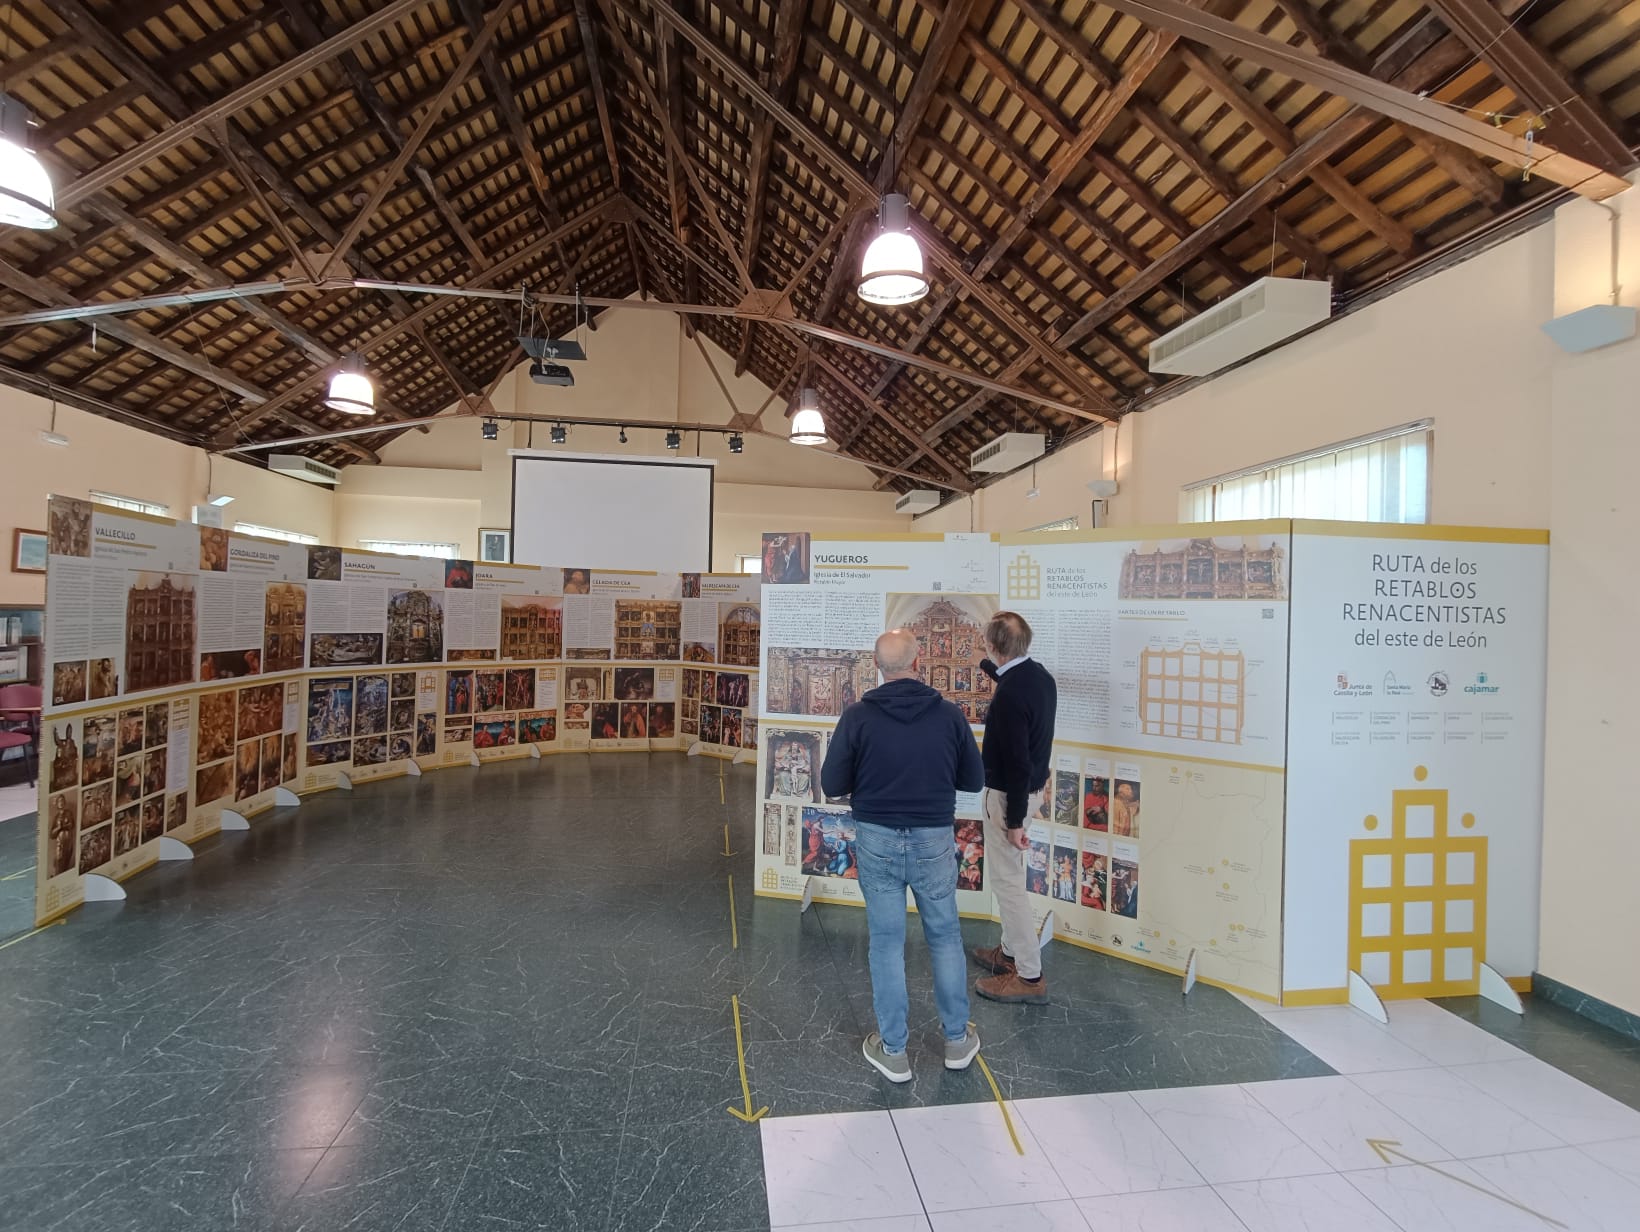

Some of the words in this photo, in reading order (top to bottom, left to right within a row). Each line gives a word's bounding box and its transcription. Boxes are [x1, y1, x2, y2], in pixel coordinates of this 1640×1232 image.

[95, 527, 136, 541] VALLECILLO
[814, 554, 869, 564] YUGUEROS
[1372, 553, 1426, 574] RUTA
[1430, 556, 1451, 574] de
[1455, 557, 1478, 576] los
[813, 570, 832, 579] Iglesia
[846, 571, 871, 579] Salvador
[1046, 582, 1108, 590] RENACENTISTAS
[1374, 578, 1477, 599] RETABLOS
[1342, 602, 1507, 625] RENACENTISTAS
[1354, 628, 1380, 647] del
[1384, 631, 1419, 648] este
[1423, 629, 1444, 648] de
[1448, 630, 1488, 649] León
[1463, 685, 1500, 696] cajamar
